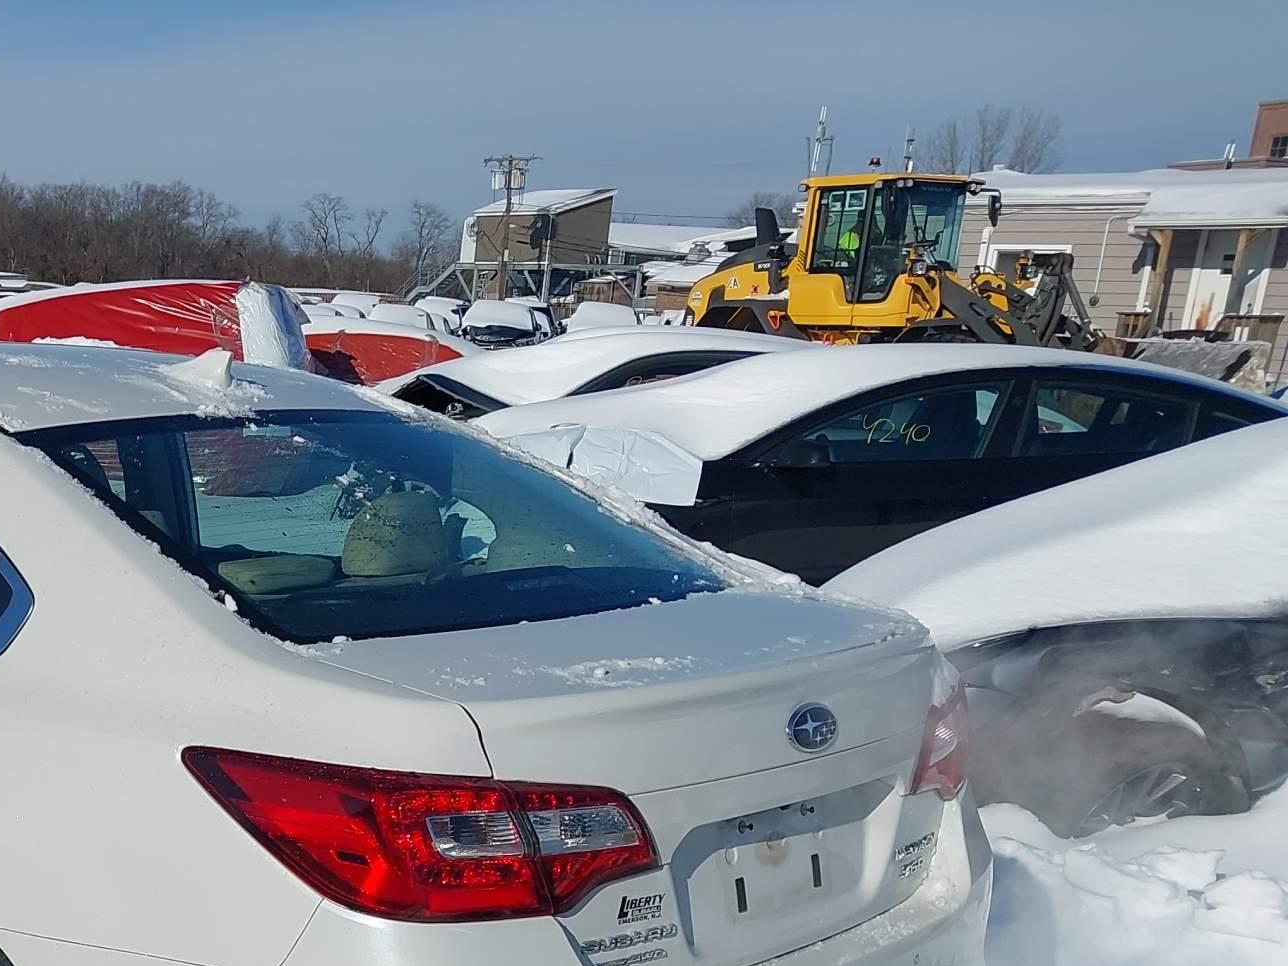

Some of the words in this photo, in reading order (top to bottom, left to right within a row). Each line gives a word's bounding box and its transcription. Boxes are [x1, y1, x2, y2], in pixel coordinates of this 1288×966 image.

[862, 413, 932, 445] 4240
[617, 892, 666, 919] LIBERTY
[581, 923, 678, 955] SUBARU
